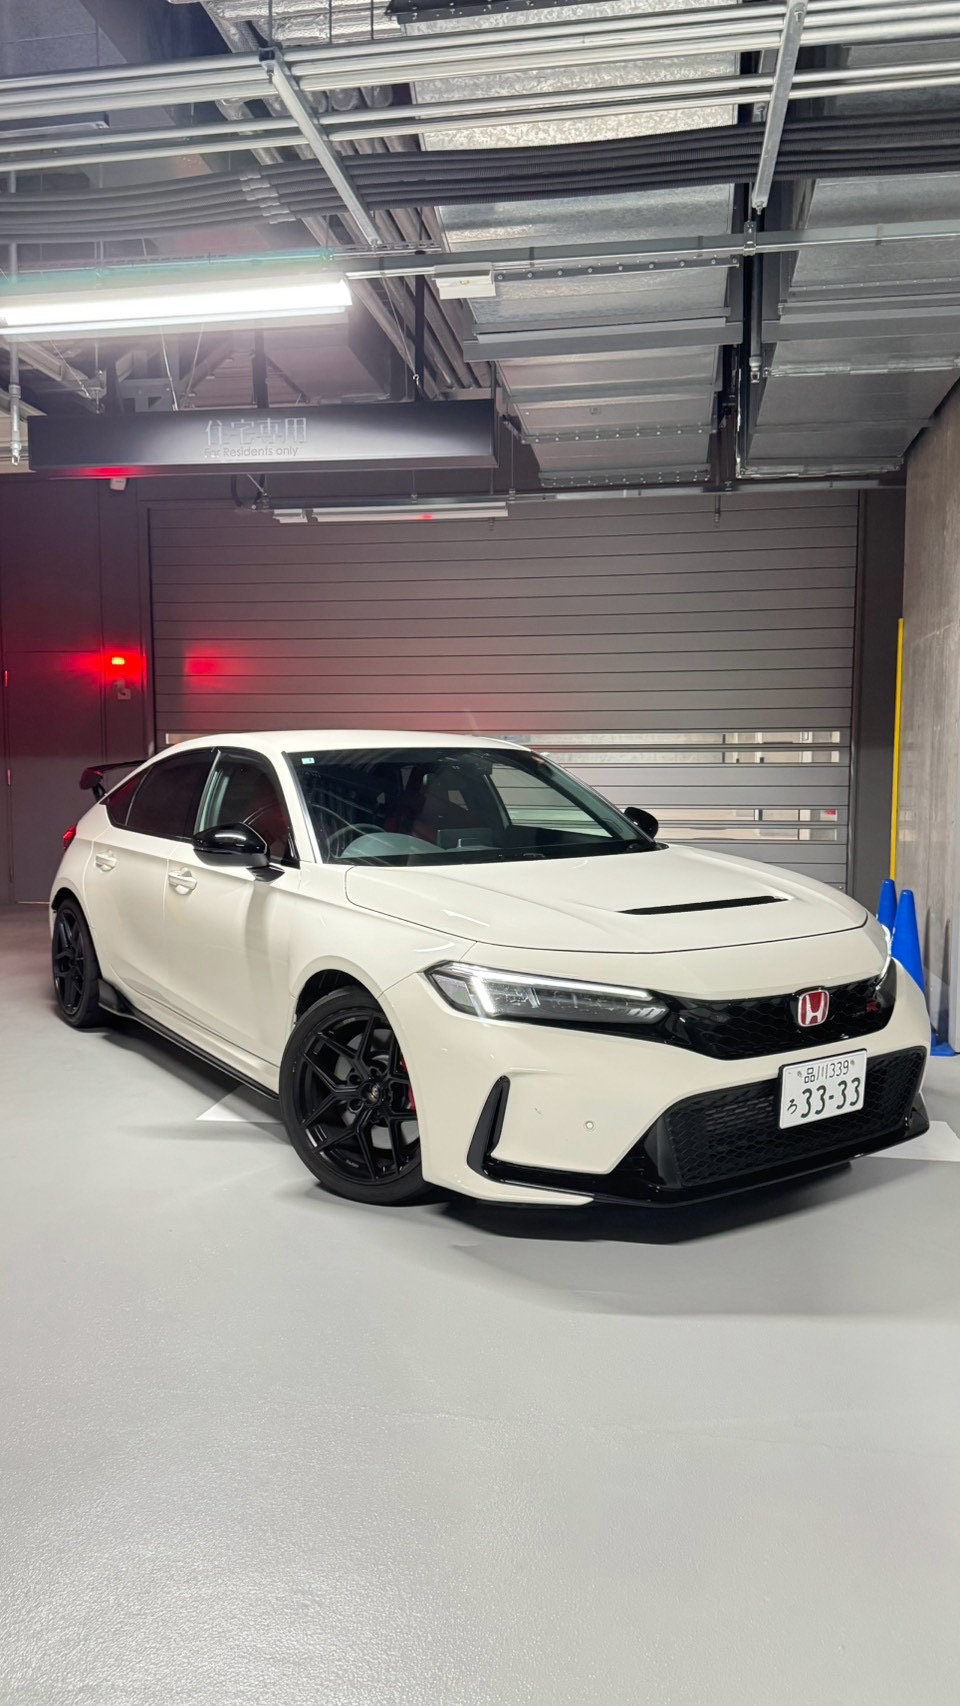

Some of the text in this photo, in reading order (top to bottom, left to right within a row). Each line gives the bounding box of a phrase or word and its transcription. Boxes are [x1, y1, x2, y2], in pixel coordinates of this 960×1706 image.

[223, 446, 273, 457] Residents
[275, 445, 299, 457] only
[800, 1077, 861, 1119] 33-33
